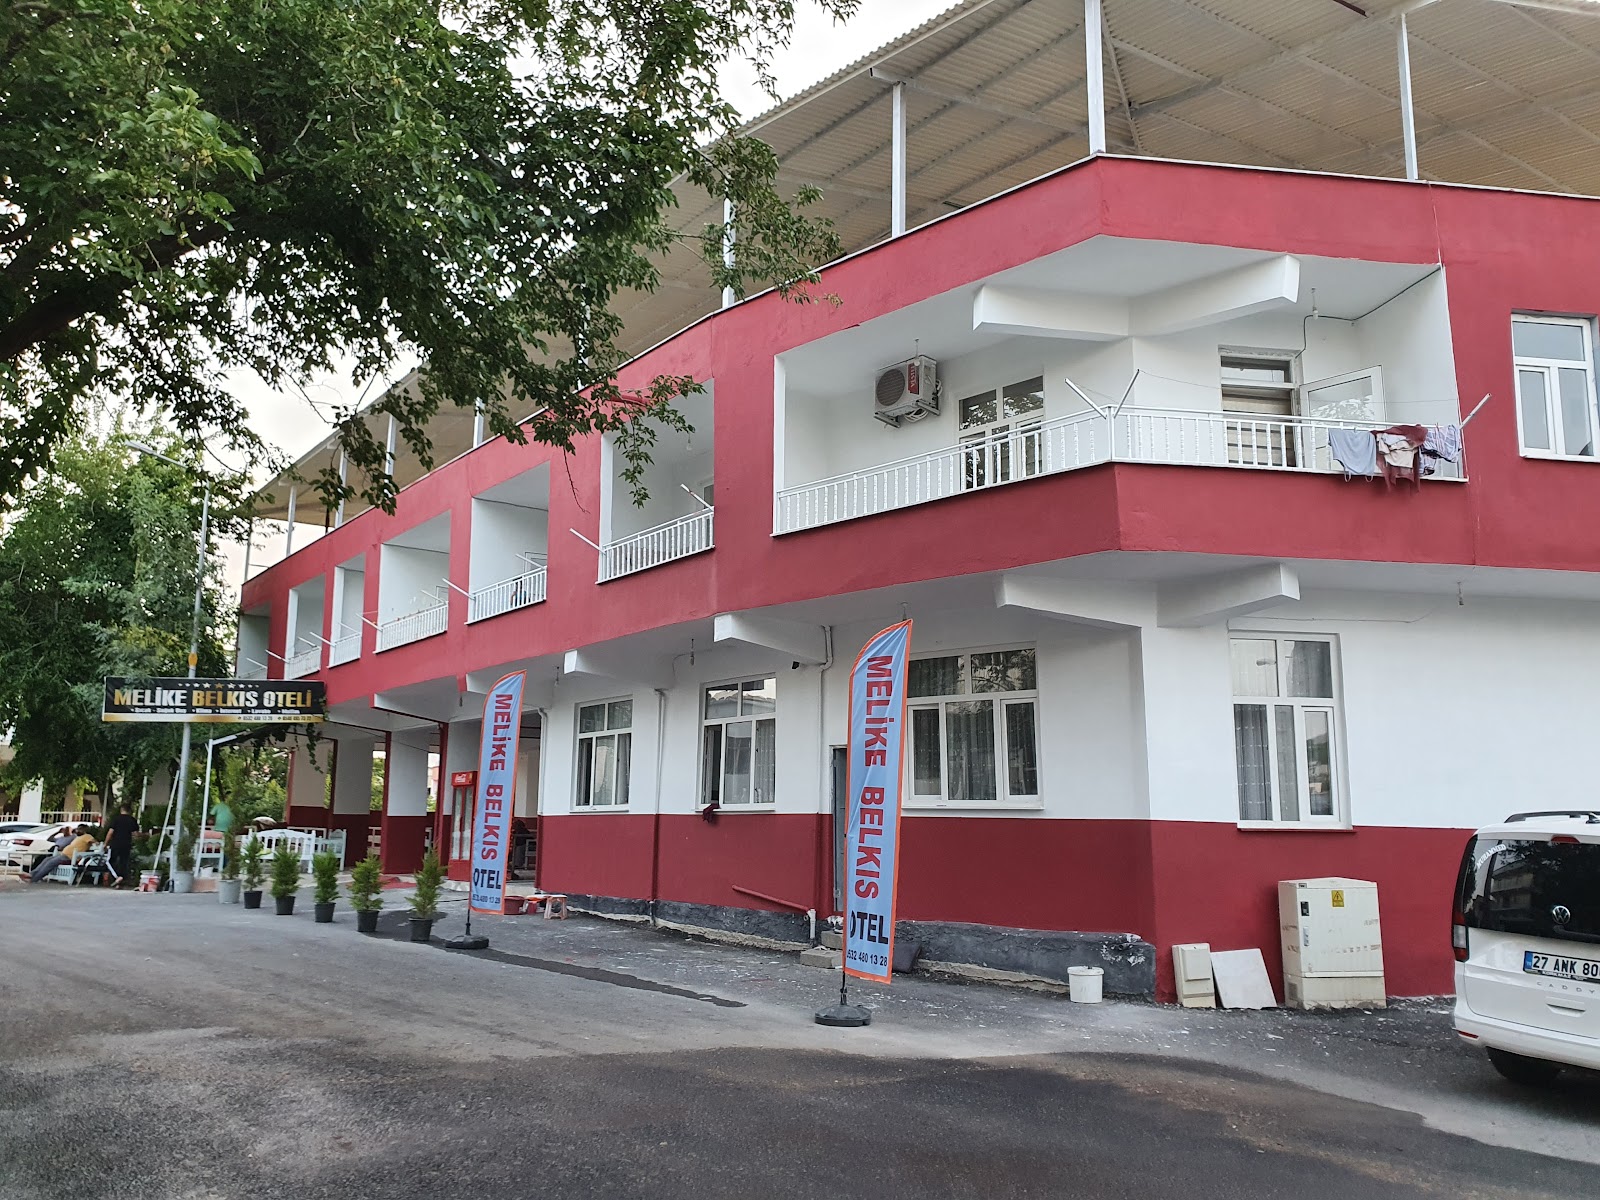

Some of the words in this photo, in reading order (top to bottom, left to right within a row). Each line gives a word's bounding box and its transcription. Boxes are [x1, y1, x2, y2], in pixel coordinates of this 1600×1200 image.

[113, 687, 187, 706] MELİKE
[192, 690, 258, 707] BELKIS
[263, 689, 312, 708] OTELİ
[865, 655, 894, 767] MELİKE
[489, 694, 513, 771] MELİKE
[481, 785, 503, 860] BELKIS
[855, 787, 885, 899] BELKIS
[473, 867, 502, 890] OTEL
[847, 949, 857, 960] 532
[870, 953, 878, 965] 13
[880, 955, 888, 967] 28
[1533, 955, 1549, 969] 27
[1553, 958, 1577, 974] ANK
[1582, 962, 1600, 977] 80
